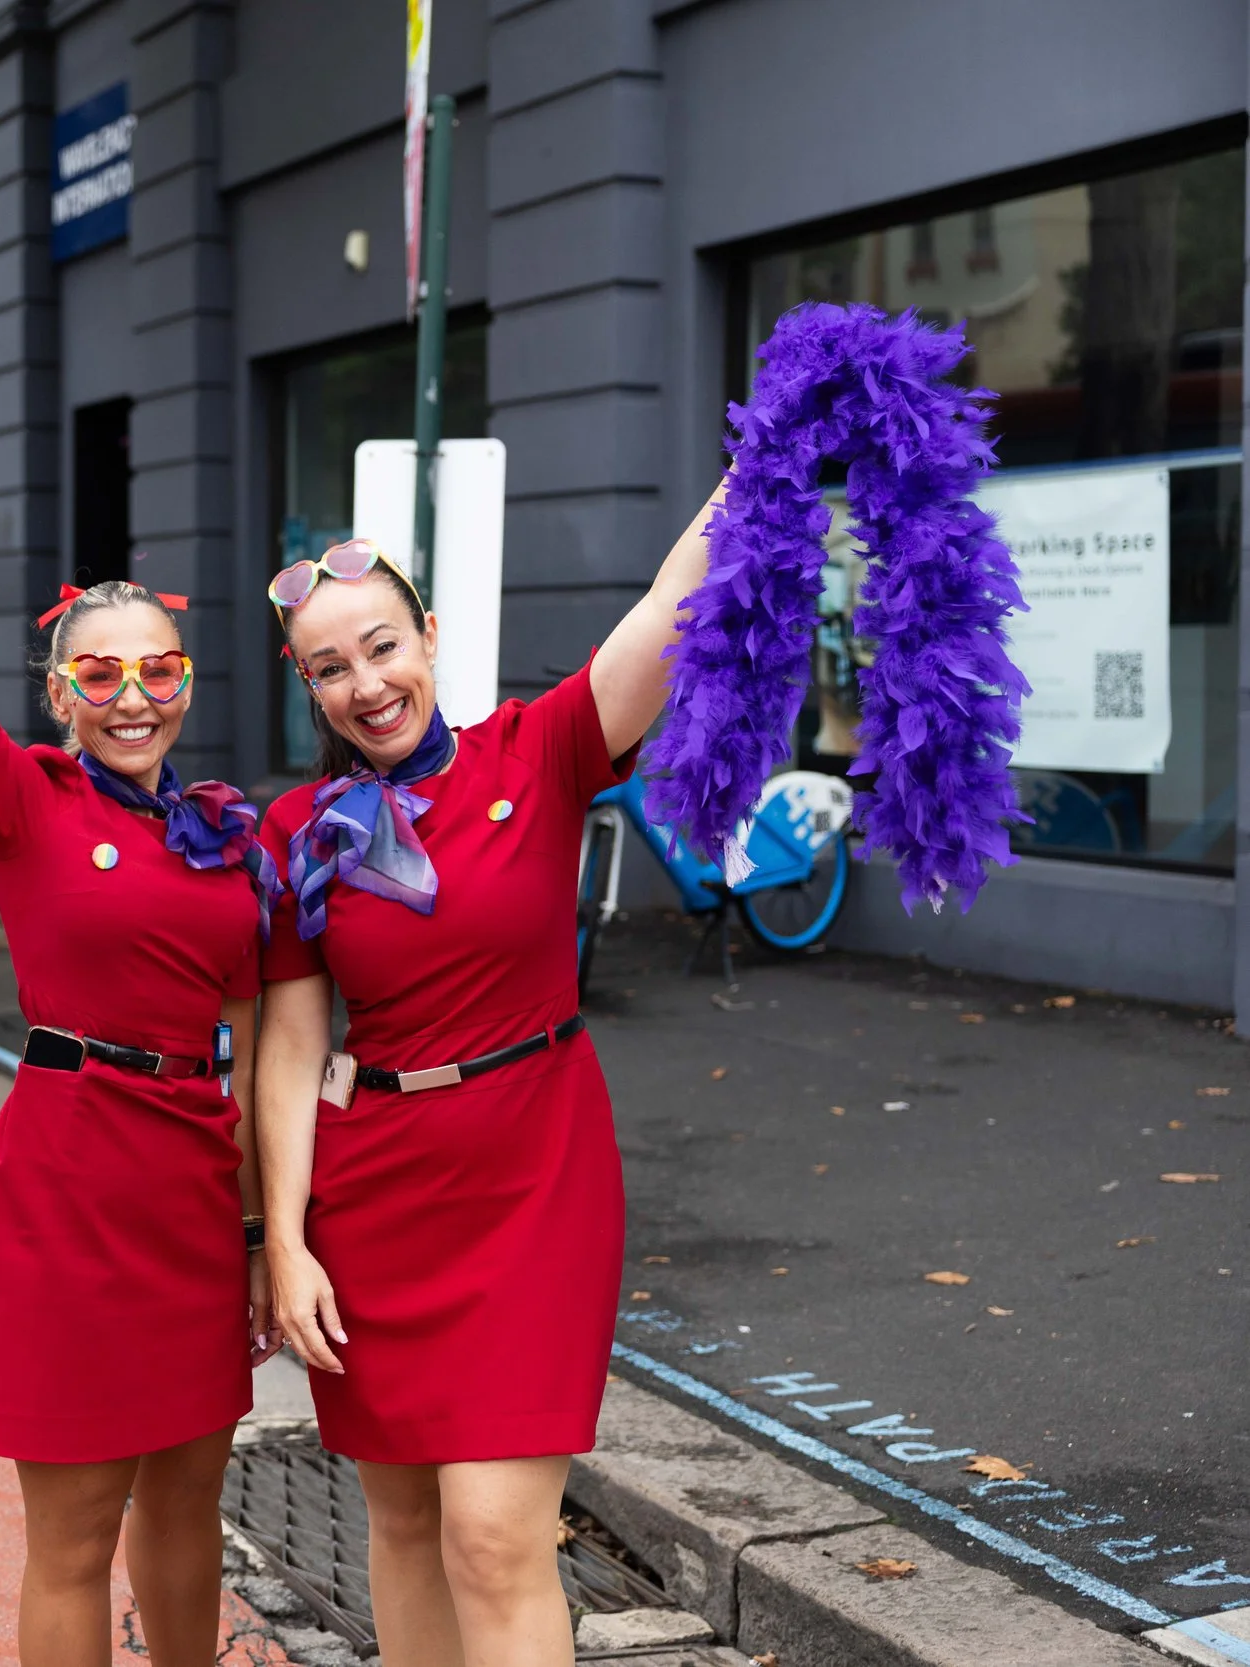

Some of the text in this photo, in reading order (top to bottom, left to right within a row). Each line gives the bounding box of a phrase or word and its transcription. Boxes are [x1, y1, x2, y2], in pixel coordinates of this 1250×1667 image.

[1008, 531, 1155, 559] orking Space
[750, 1371, 977, 1464] PATH
